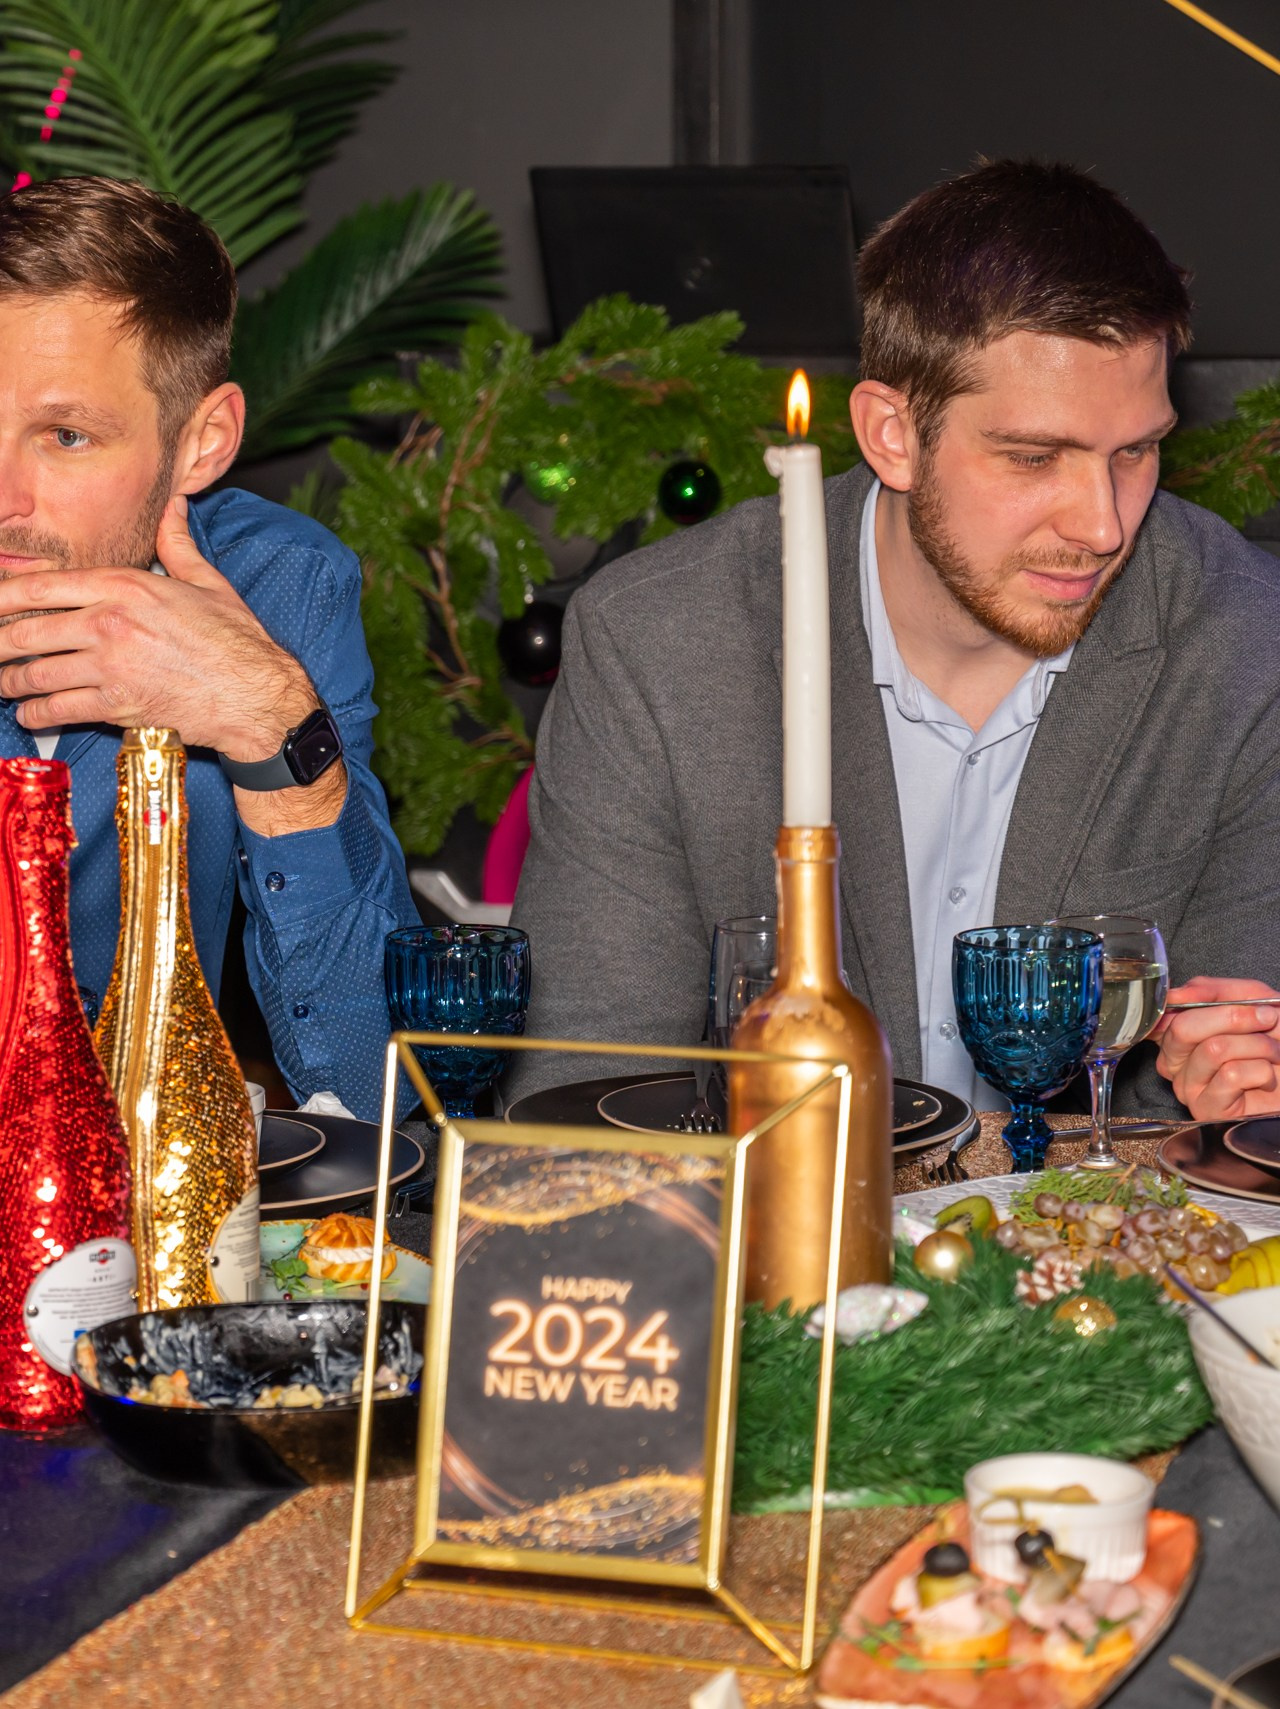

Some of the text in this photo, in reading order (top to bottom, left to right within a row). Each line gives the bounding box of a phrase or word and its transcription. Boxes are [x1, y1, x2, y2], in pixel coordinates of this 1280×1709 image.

[541, 1275, 633, 1304] HAPPY
[488, 1299, 680, 1374] 2024
[484, 1365, 679, 1411] NEW YEAR
